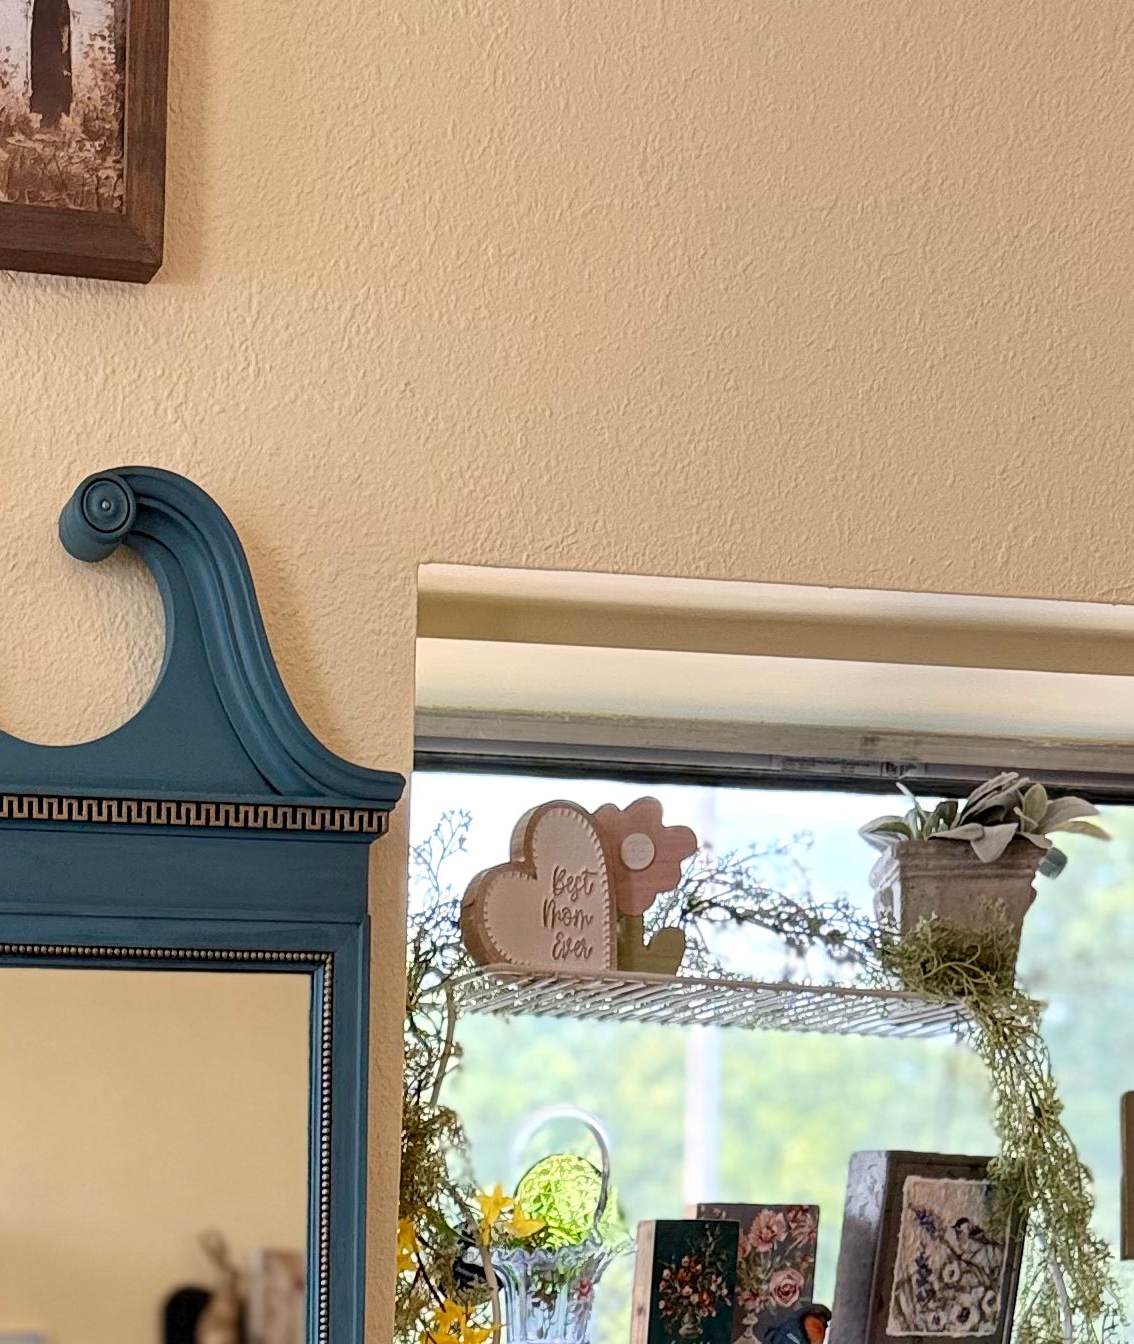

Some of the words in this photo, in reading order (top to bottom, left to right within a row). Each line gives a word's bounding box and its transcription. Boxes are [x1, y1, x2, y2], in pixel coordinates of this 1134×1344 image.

[552, 865, 598, 902] Best
[543, 898, 594, 930] Mom
[552, 931, 594, 961] Ever
